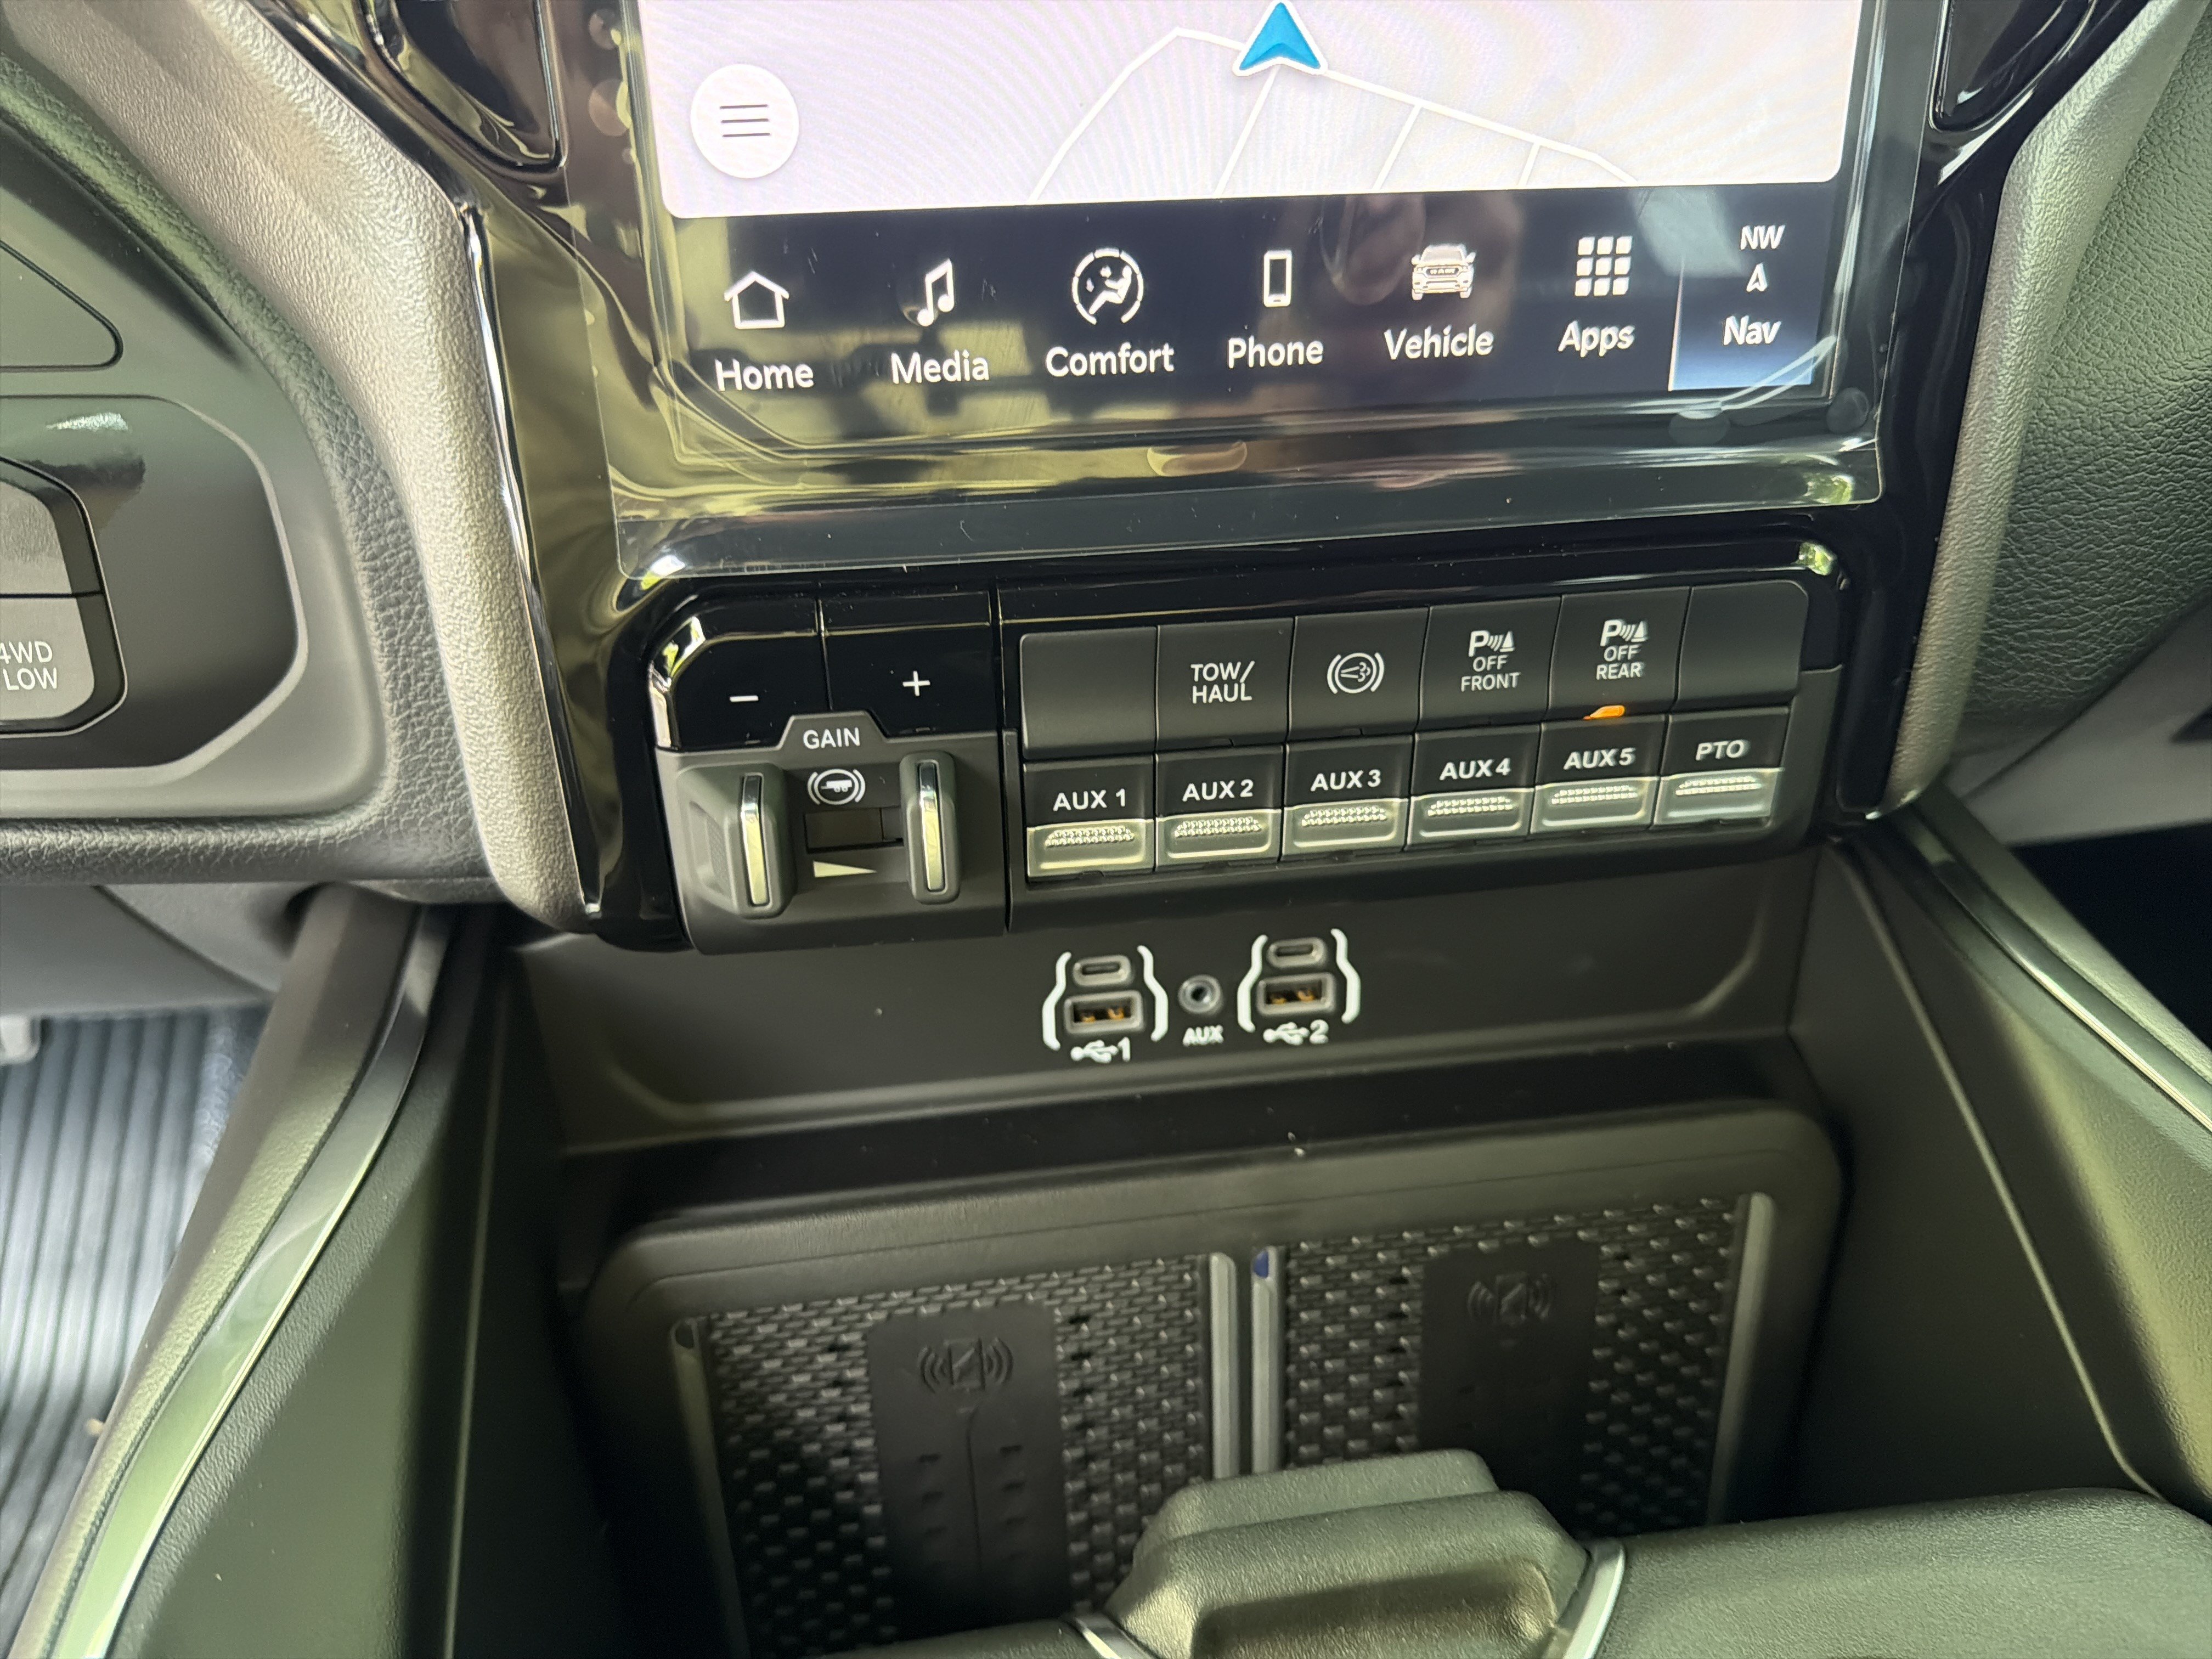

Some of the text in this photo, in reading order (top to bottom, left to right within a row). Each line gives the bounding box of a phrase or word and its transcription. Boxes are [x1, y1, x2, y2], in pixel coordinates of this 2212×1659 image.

[1740, 225, 1785, 250] NW
[1384, 324, 1494, 360] Vehicle
[1558, 320, 1635, 358] Apps
[1723, 315, 1781, 346] Nav
[1045, 342, 1175, 377] Comfort
[1228, 335, 1324, 369] Phone
[715, 359, 814, 392] Home
[891, 349, 989, 384] Media
[0, 641, 53, 664] 4WD
[1472, 656, 1508, 672] OFF
[1604, 645, 1639, 662] OFF
[2, 667, 57, 691] LOW
[1190, 661, 1255, 683] TOW/
[1461, 672, 1520, 692] FRONT
[1596, 662, 1643, 680] REAR
[1192, 682, 1252, 704] HAUL
[803, 727, 861, 749] GAIN
[1564, 747, 1635, 770] AUX 5
[1695, 740, 1748, 761] PTO
[1310, 769, 1381, 792] AUX 3
[1439, 758, 1511, 781] AUX 4
[1053, 788, 1126, 811] AUX 1
[1182, 779, 1254, 802] AUX 2
[1182, 1025, 1223, 1046] AUX
[1310, 1019, 1329, 1043] 2
[1117, 1037, 1131, 1061] 1
